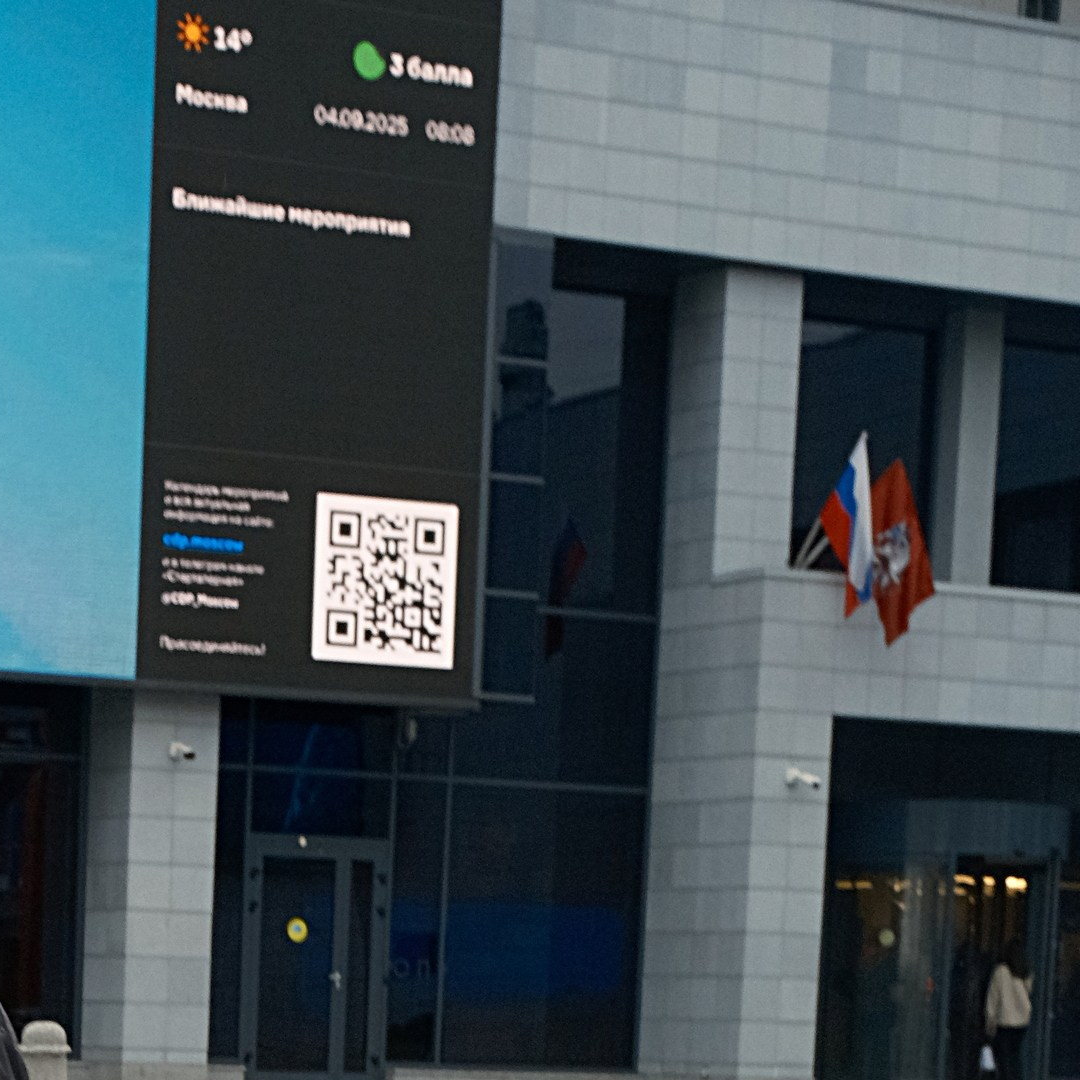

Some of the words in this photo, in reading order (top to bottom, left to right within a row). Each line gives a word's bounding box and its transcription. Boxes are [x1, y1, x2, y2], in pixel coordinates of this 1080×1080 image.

[389, 52, 405, 78] 3
[406, 55, 474, 89] балла
[175, 82, 249, 114] Москва
[172, 186, 286, 223] Ближайшие
[287, 206, 411, 239] мероприятия
